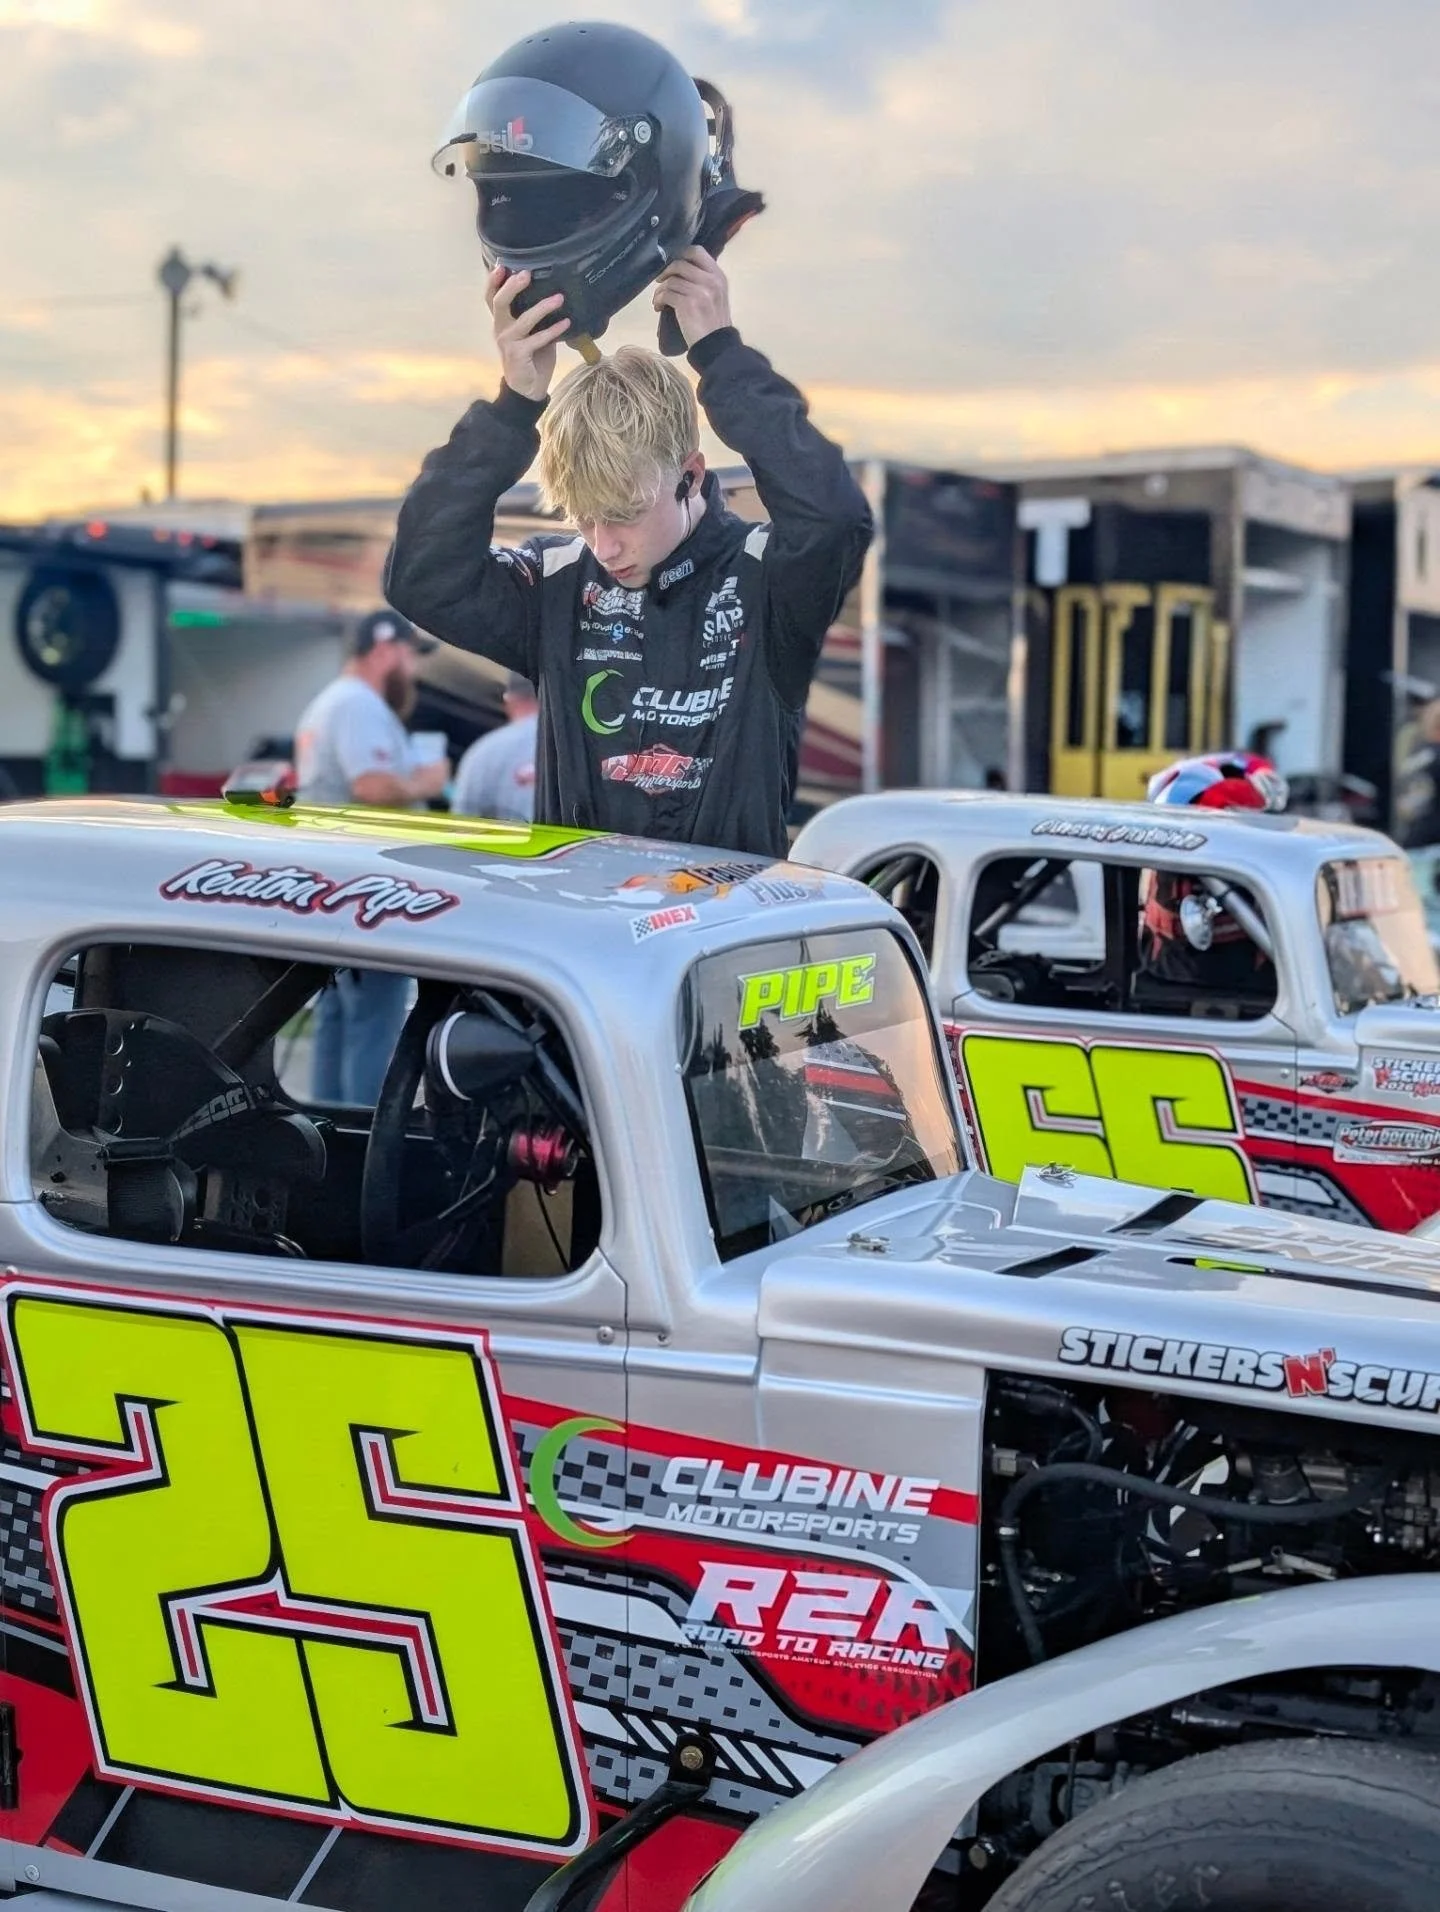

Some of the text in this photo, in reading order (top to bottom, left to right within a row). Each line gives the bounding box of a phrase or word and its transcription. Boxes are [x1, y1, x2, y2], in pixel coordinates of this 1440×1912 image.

[631, 676, 735, 713] CLUBIE
[163, 859, 457, 928] Keaton Pipe
[650, 905, 696, 930] INEX
[738, 953, 877, 1030] PIPE
[660, 1456, 941, 1517] CLUBINE
[664, 1502, 921, 1545] MOTORSPORTS
[3, 1284, 590, 1854] 25
[687, 1560, 950, 1650] R2R
[681, 1623, 947, 1670] ROAD TO RACING
[791, 1655, 831, 1666] AMATEUR
[881, 1665, 938, 1679] ASSOCIATION
